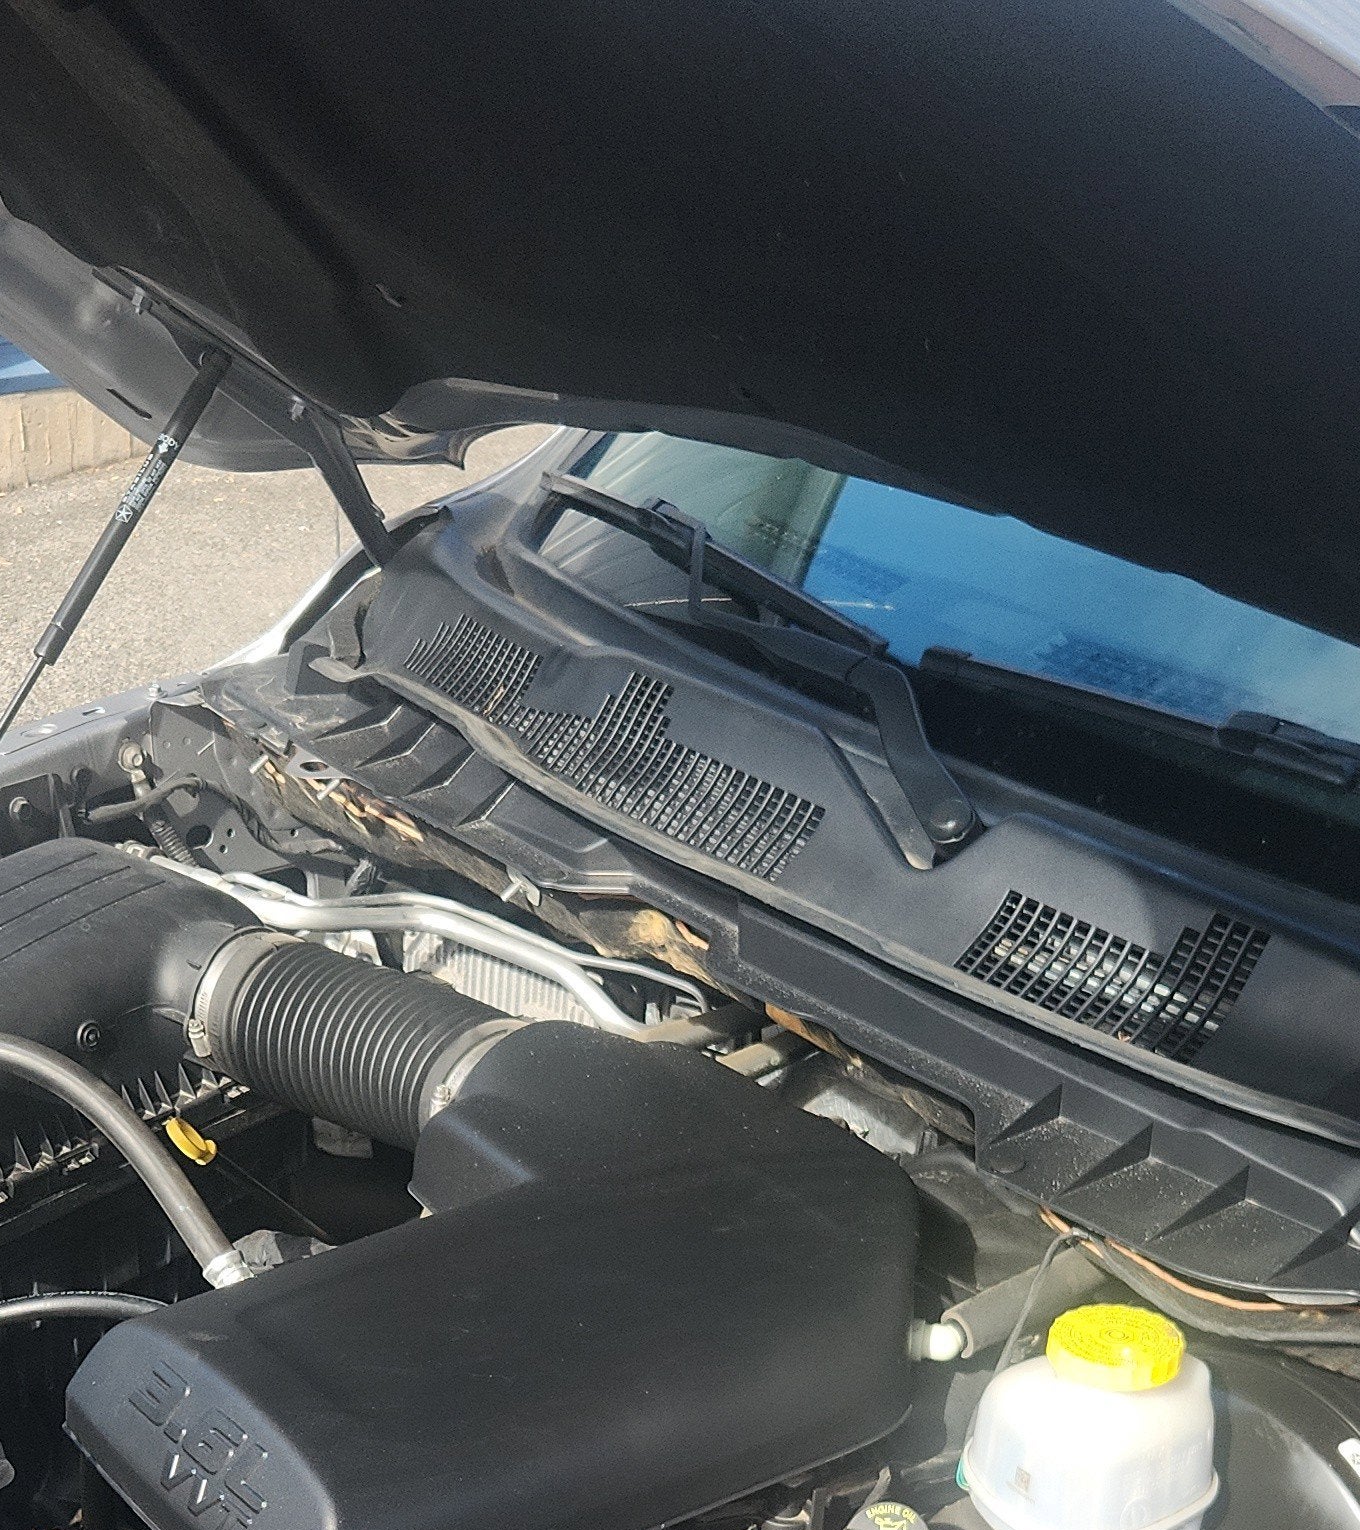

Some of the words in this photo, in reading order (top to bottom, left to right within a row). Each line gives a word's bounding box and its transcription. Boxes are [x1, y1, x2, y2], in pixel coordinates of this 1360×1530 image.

[128, 1360, 269, 1514] 3.6L
[865, 1505, 901, 1519] ENGINE
[901, 1508, 917, 1524] OIL
